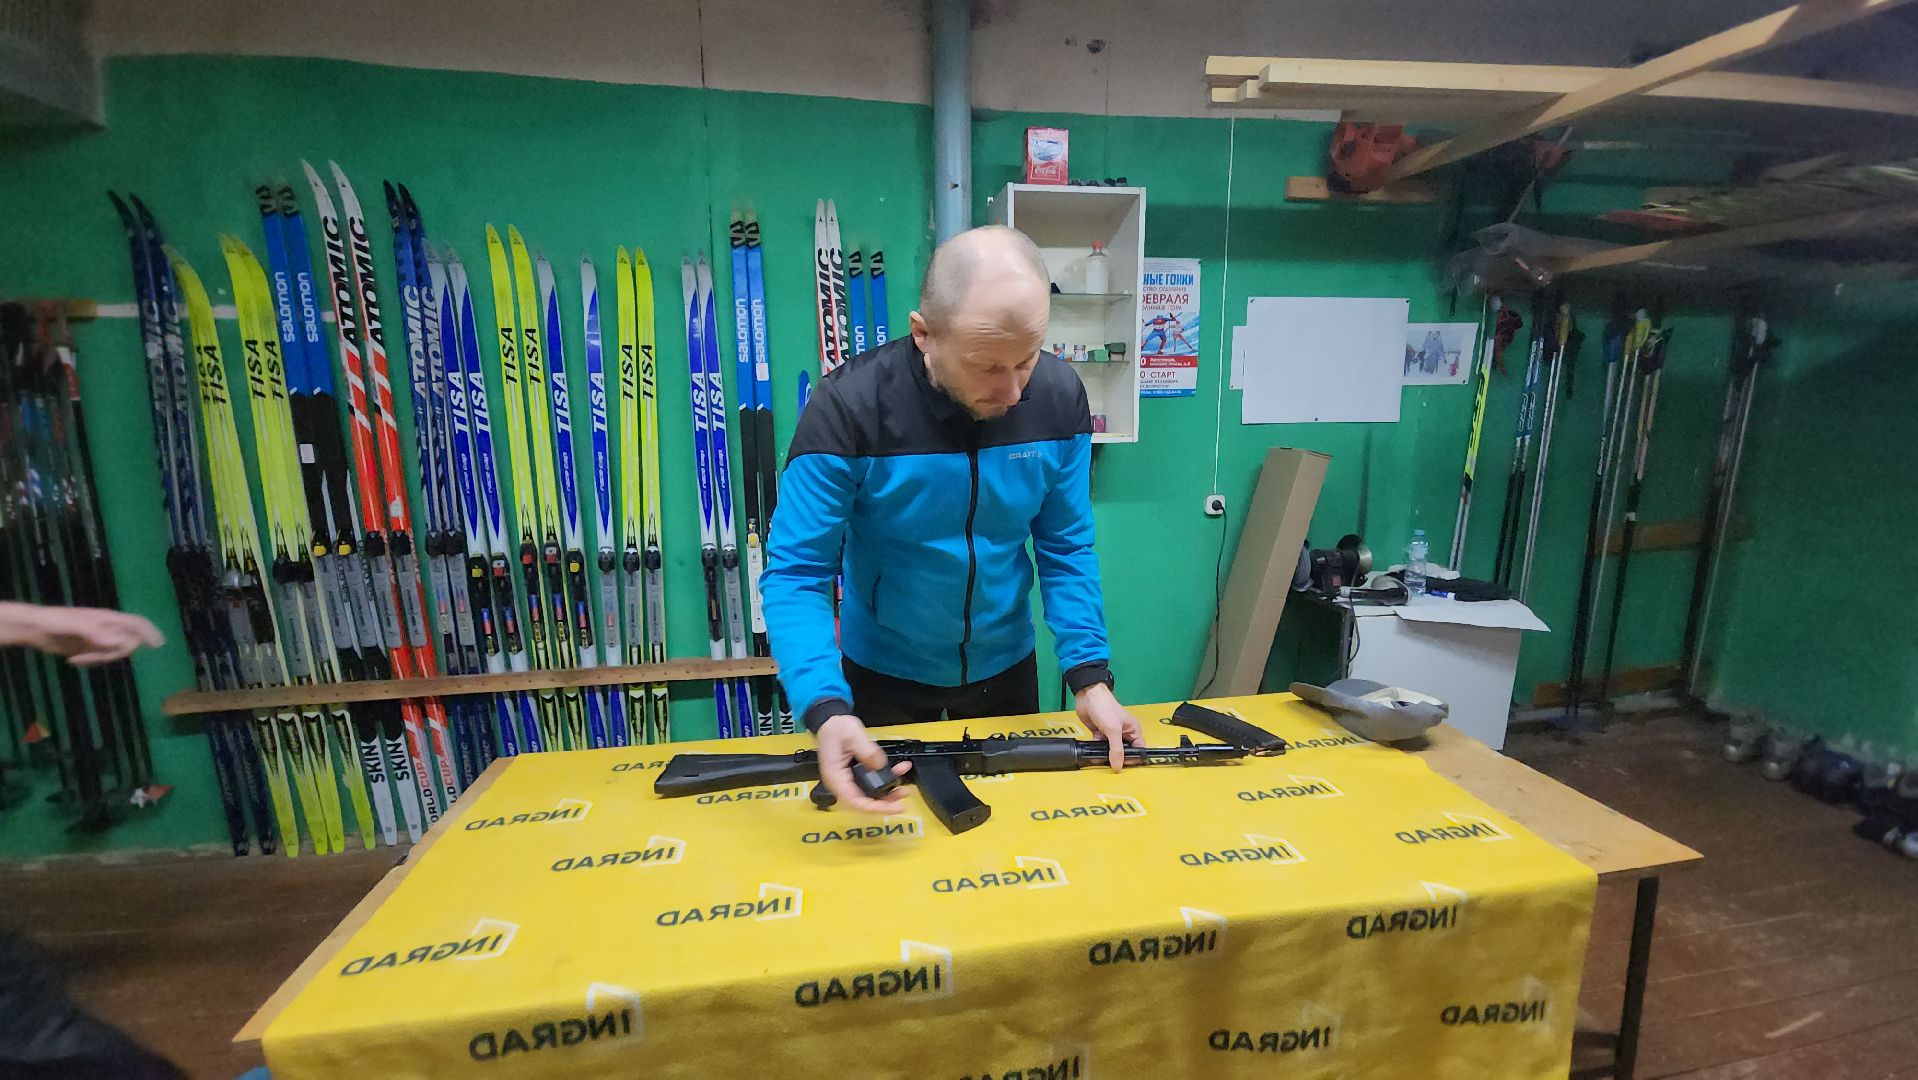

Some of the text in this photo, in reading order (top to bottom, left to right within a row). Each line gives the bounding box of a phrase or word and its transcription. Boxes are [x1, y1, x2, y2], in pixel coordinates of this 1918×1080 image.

[274, 271, 296, 342] salomon
[298, 272, 319, 343] salomon
[322, 215, 357, 347] ATOMIC
[349, 216, 383, 345] ATOMIC
[817, 247, 837, 366] ATOMIC
[829, 248, 851, 362] ATOMIC
[1143, 273, 1193, 286] НЫЕ ГОНКИ
[403, 285, 427, 399] ATOMIC
[421, 286, 446, 399] ATOMIC
[501, 327, 518, 385] TISA
[524, 328, 542, 385] TISA
[735, 298, 750, 363] salomon
[751, 298, 766, 364] salomon
[203, 345, 227, 405] TISA
[245, 339, 267, 399] TISA
[264, 340, 284, 400] TISA
[621, 344, 634, 400] TISA
[641, 344, 655, 400] TISA
[1150, 371, 1176, 379] СТАРТ
[448, 372, 469, 435] TISA
[469, 372, 492, 435] TISA
[552, 372, 572, 435] TISA
[590, 372, 609, 435] TISA
[692, 372, 709, 435] TISA
[709, 372, 726, 435] TISA
[1008, 451, 1035, 460] CRAFT
[362, 744, 385, 784] SKIN
[386, 743, 409, 781] SKIN
[416, 761, 439, 823] ORLDCUP
[441, 759, 457, 803] LDCUP
